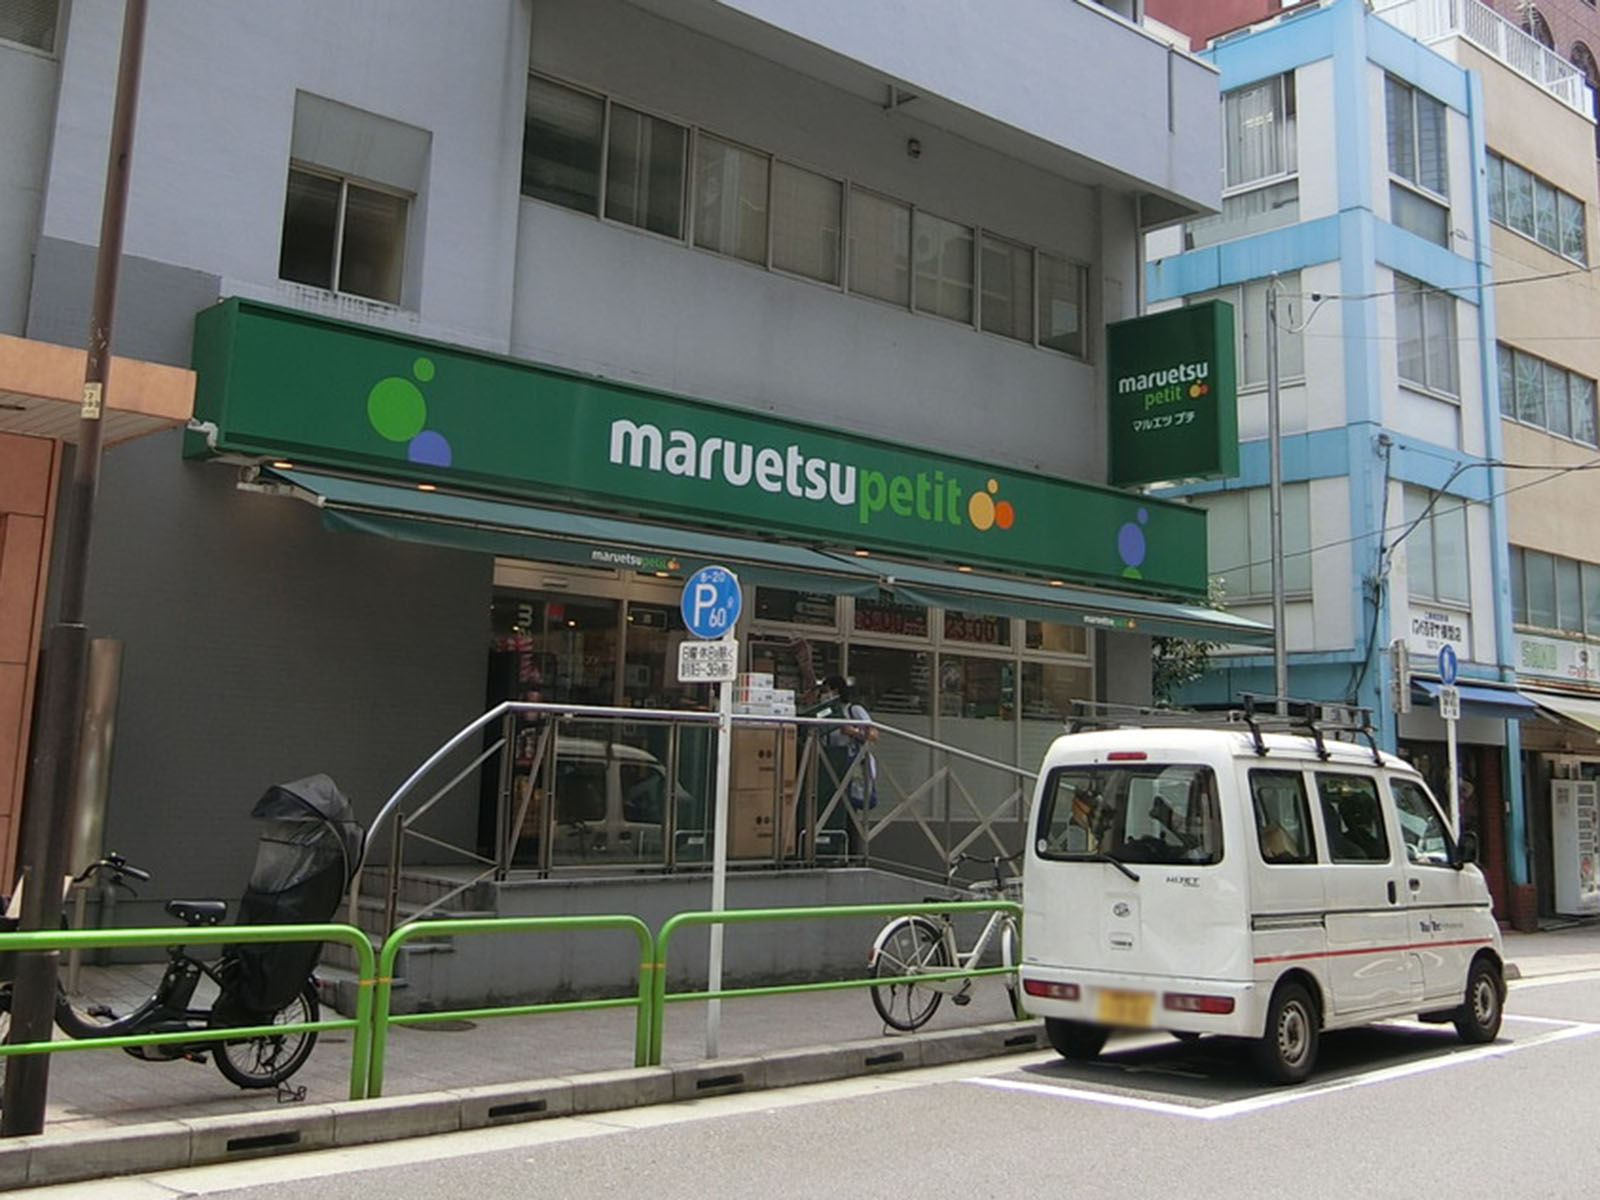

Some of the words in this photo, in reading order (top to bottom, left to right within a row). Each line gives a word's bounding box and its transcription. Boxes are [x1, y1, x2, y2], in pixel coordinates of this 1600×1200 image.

[1118, 362, 1208, 394] maruetsu
[1144, 385, 1182, 410] petit
[1133, 415, 1172, 431] マルエツ
[693, 583, 718, 628] P
[708, 607, 727, 628] 60
